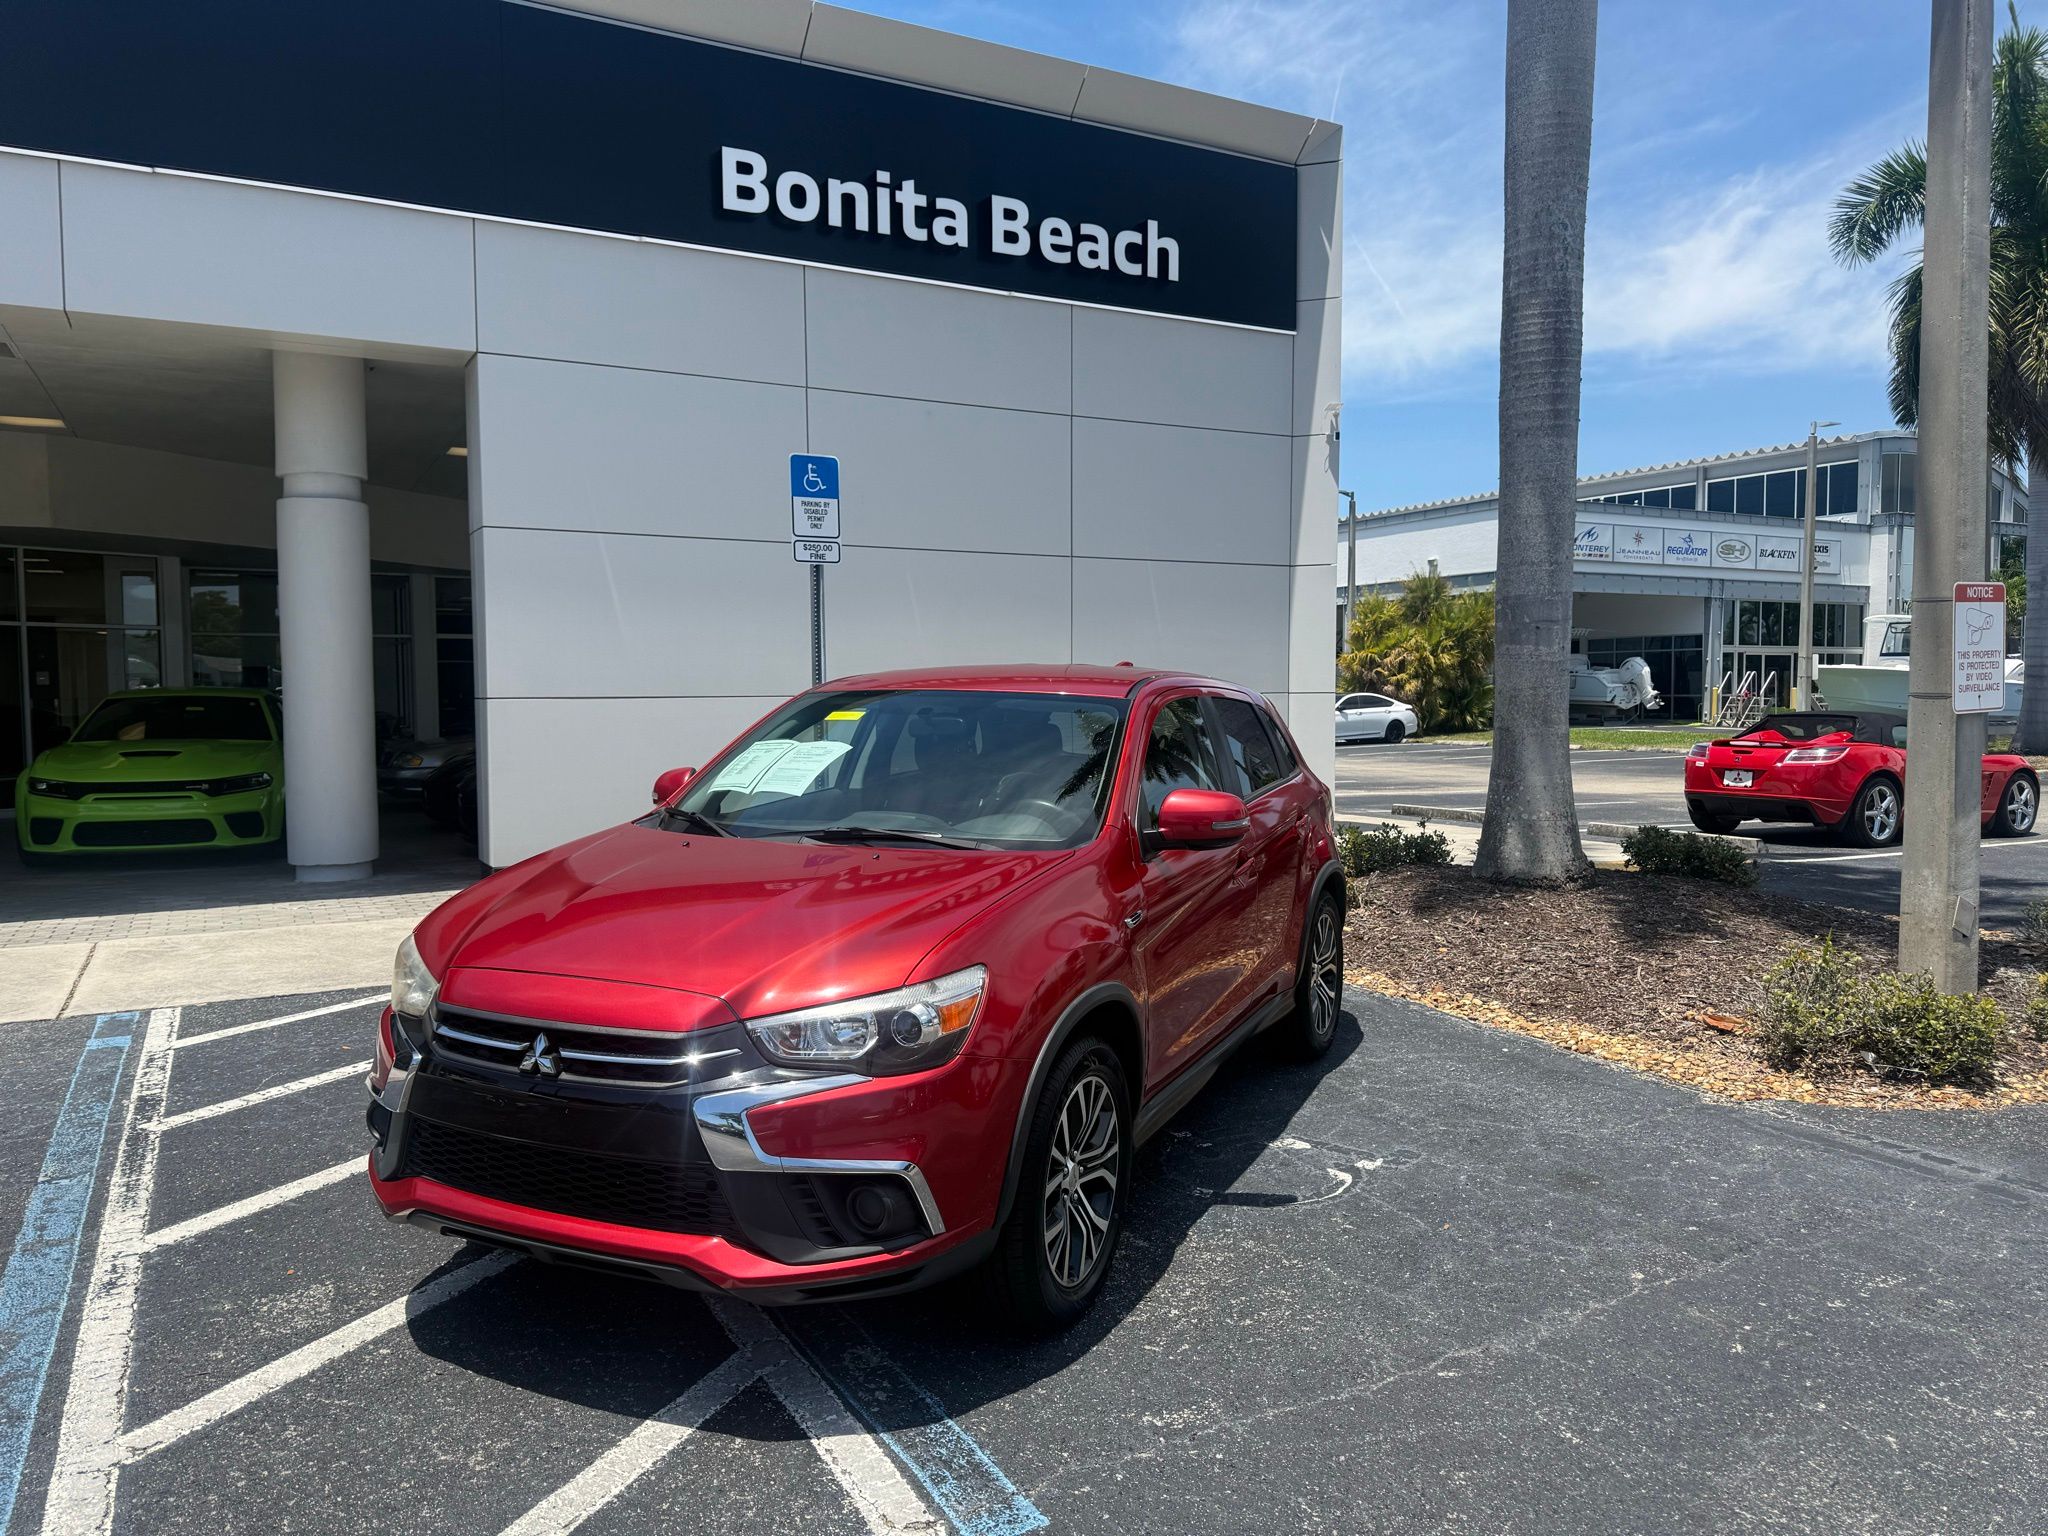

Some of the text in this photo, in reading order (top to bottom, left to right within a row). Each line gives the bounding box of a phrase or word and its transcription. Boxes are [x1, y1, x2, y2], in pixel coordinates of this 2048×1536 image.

[721, 145, 1180, 282] Bonita Beach
[803, 544, 833, 552] $250.00
[1573, 544, 1610, 553] ONTEREY
[1616, 548, 1661, 556] JEANNEAU
[1666, 546, 1708, 557] REGULATOR
[1759, 548, 1797, 560] BLACKFIN
[1966, 587, 1994, 598] NOTICE
[1957, 650, 2002, 659] THIS PROPERTY
[1958, 661, 2000, 671] IS PROTECTED
[1965, 672, 1993, 681] BY VIDEO
[1958, 682, 2001, 693] SURVEILLANCE
